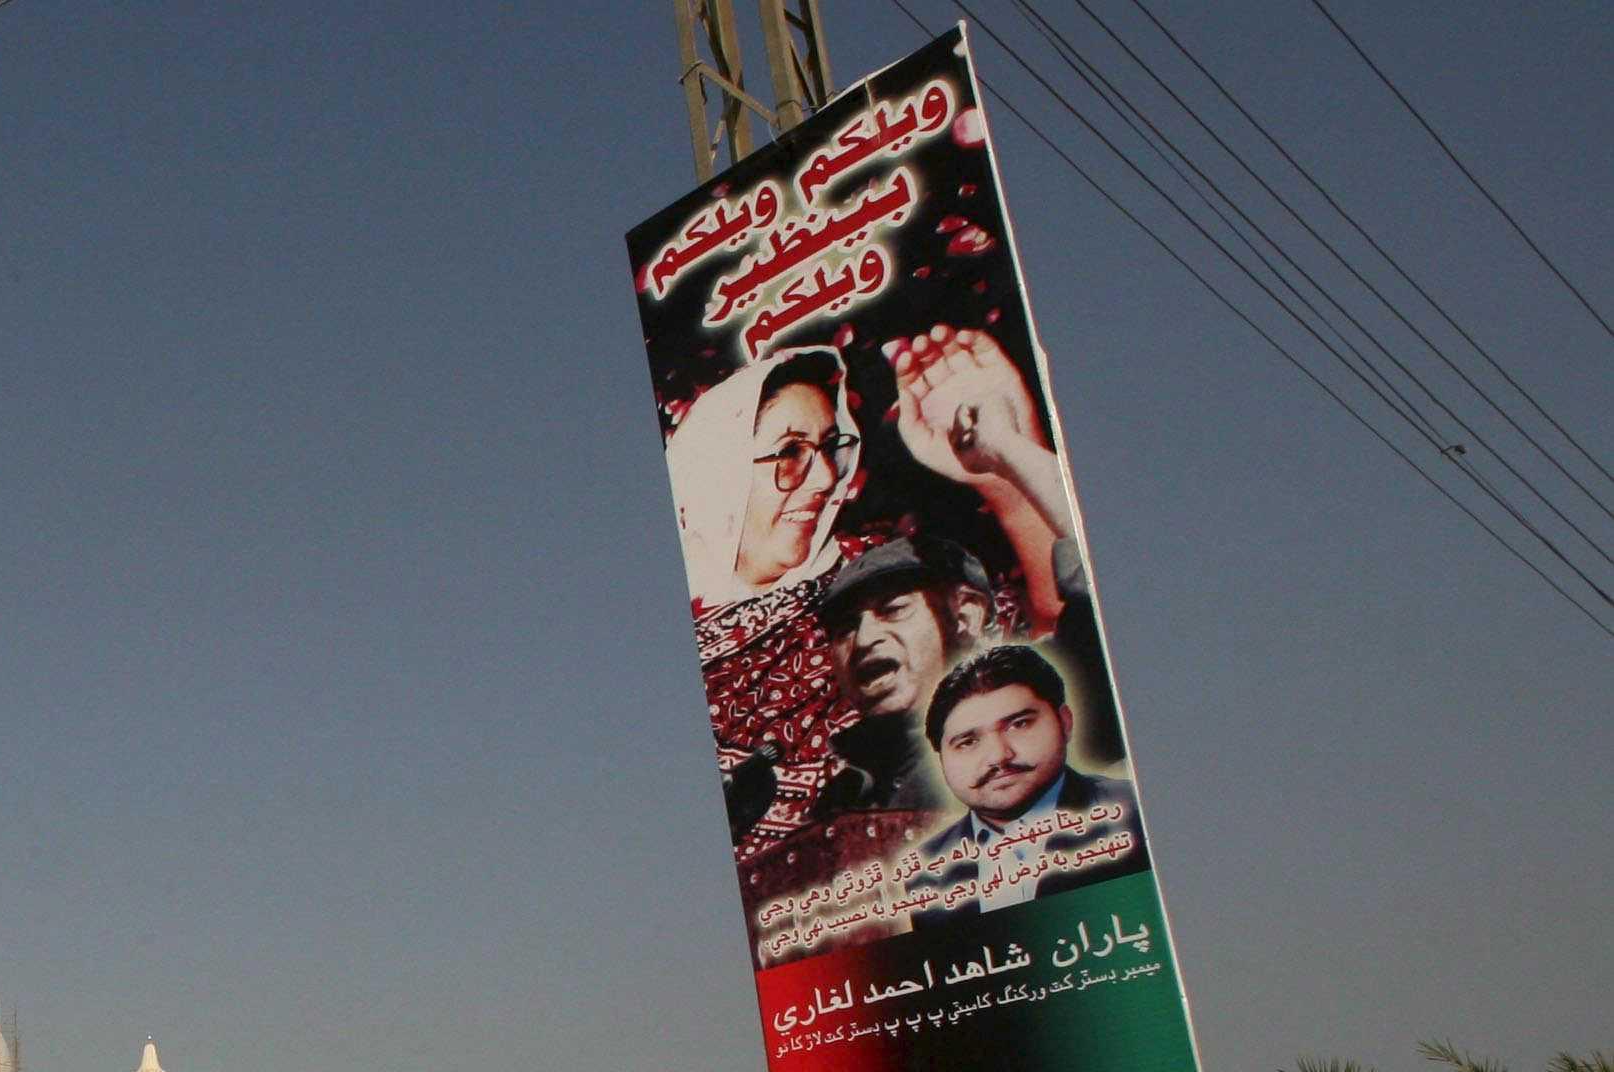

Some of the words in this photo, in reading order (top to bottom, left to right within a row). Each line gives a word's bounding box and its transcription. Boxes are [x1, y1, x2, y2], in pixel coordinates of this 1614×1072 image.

[711, 175, 911, 321] بينظير
[944, 943, 1031, 985] شاهد
[1052, 914, 1150, 968] پاران
[863, 960, 934, 1004] احمد
